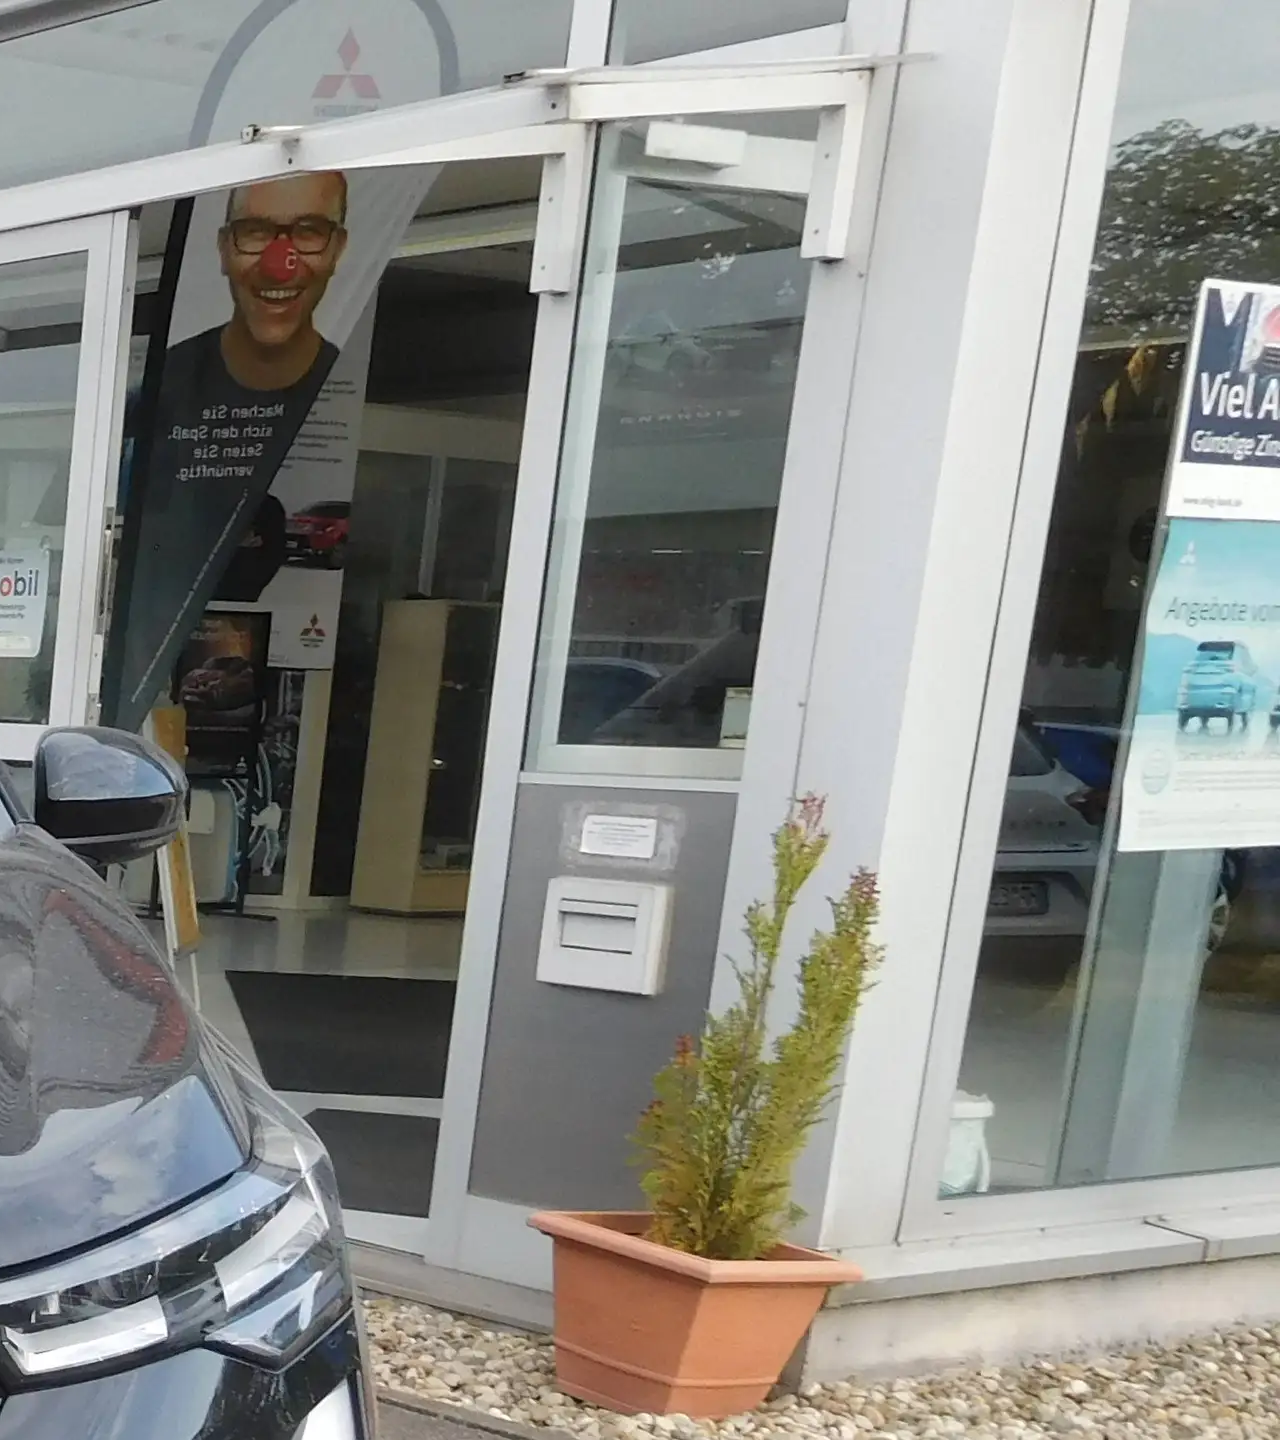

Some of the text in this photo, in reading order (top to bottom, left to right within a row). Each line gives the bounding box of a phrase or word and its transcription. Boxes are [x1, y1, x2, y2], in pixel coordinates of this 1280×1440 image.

[1201, 372, 1280, 421] Viel A
[1190, 430, 1255, 460] Günstige
[1163, 596, 1248, 628] Angebote
